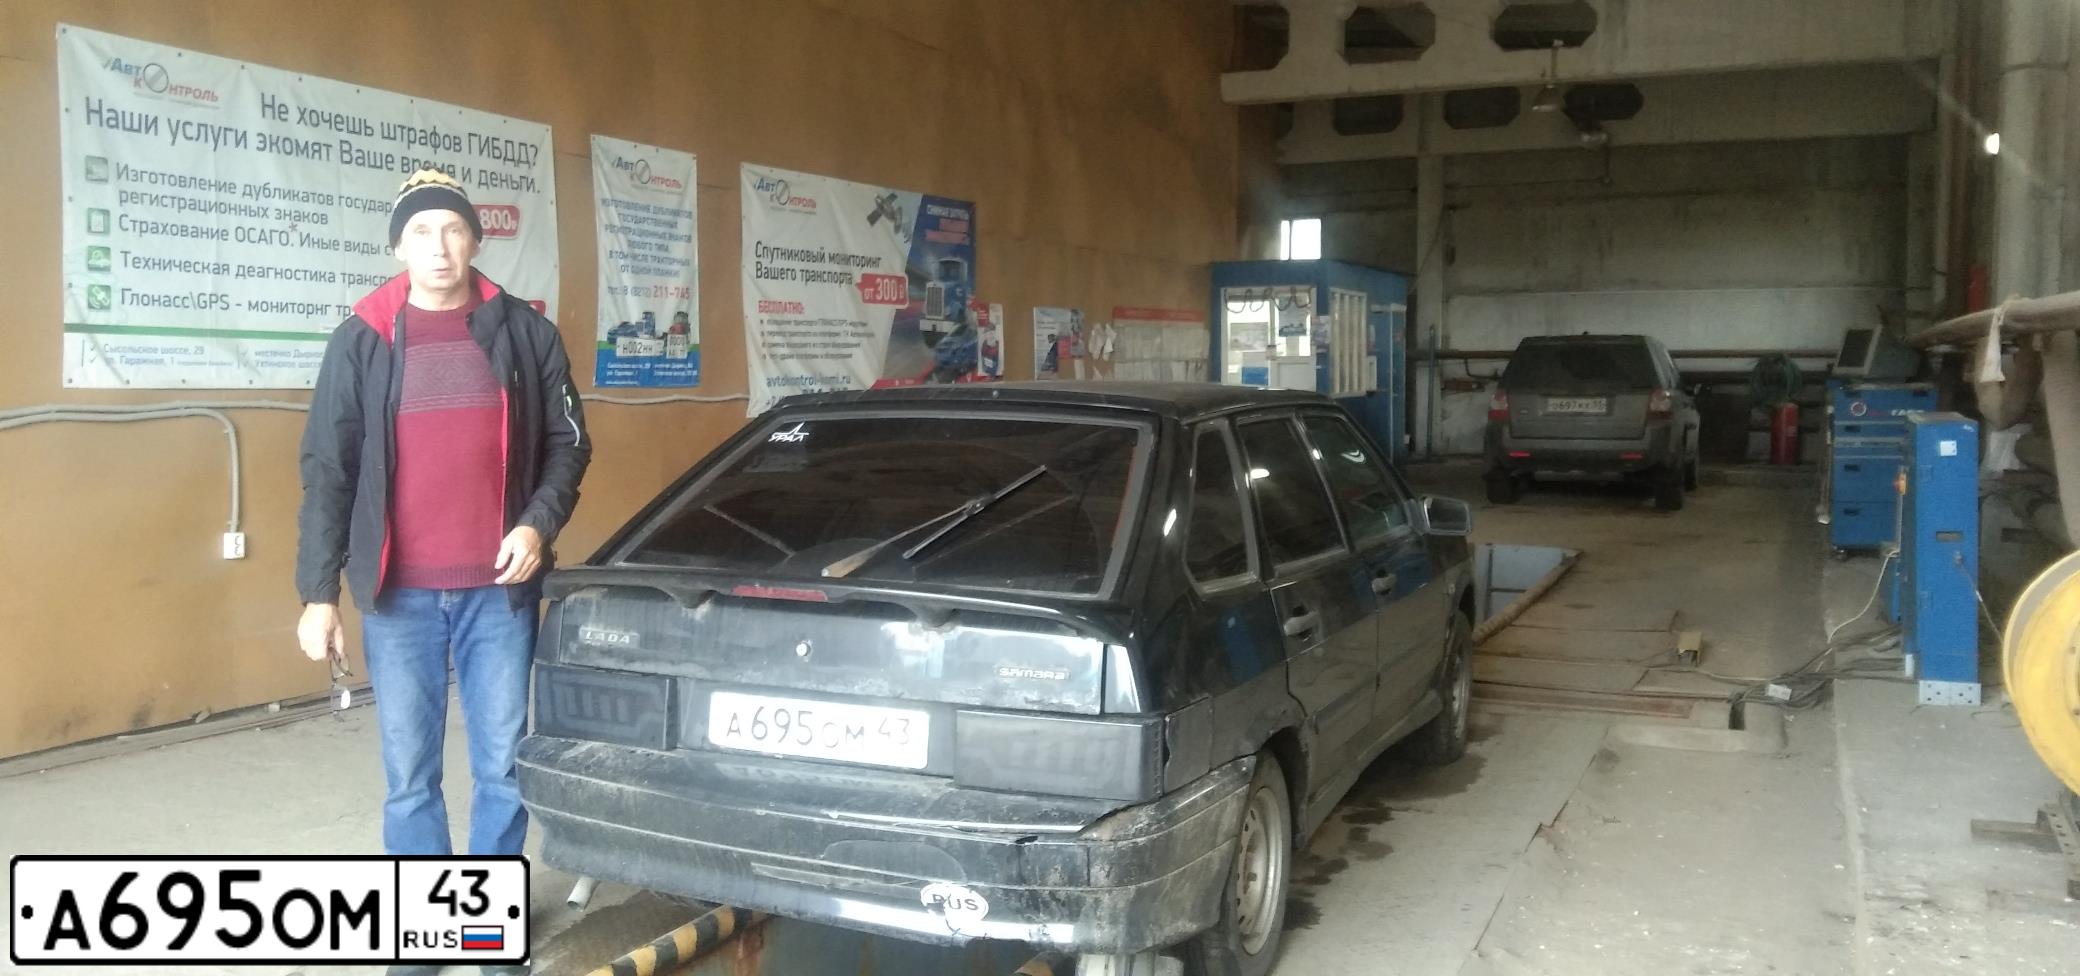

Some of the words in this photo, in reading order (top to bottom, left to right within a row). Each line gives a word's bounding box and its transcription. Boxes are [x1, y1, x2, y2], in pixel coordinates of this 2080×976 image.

[85, 96, 159, 136] Наши
[167, 117, 247, 152] услуги
[256, 132, 333, 162] экомят
[340, 140, 394, 171] Ваше
[462, 165, 472, 183] и
[478, 169, 541, 195] деньги.
[260, 92, 288, 122] Не
[297, 106, 375, 137] хочешь
[381, 121, 462, 153] штрафов
[468, 132, 539, 168] ГИБДД?
[116, 162, 237, 194] Изготовление
[242, 182, 337, 206] дубликатов
[338, 193, 392, 216] государ
[118, 189, 269, 219] регистрационных
[274, 209, 328, 225] знаков
[118, 214, 229, 241] Страхование
[300, 230, 341, 251] Иные
[344, 240, 380, 257] виды
[120, 251, 230, 276] Техническая
[236, 265, 336, 284] деагностика
[755, 240, 826, 265] Спутниковый
[829, 253, 882, 269] мониторинг
[755, 261, 797, 281] Вашего
[799, 268, 853, 288] транспорта
[875, 278, 897, 302] 300
[336, 304, 352, 319] тр
[585, 630, 631, 645] LADA
